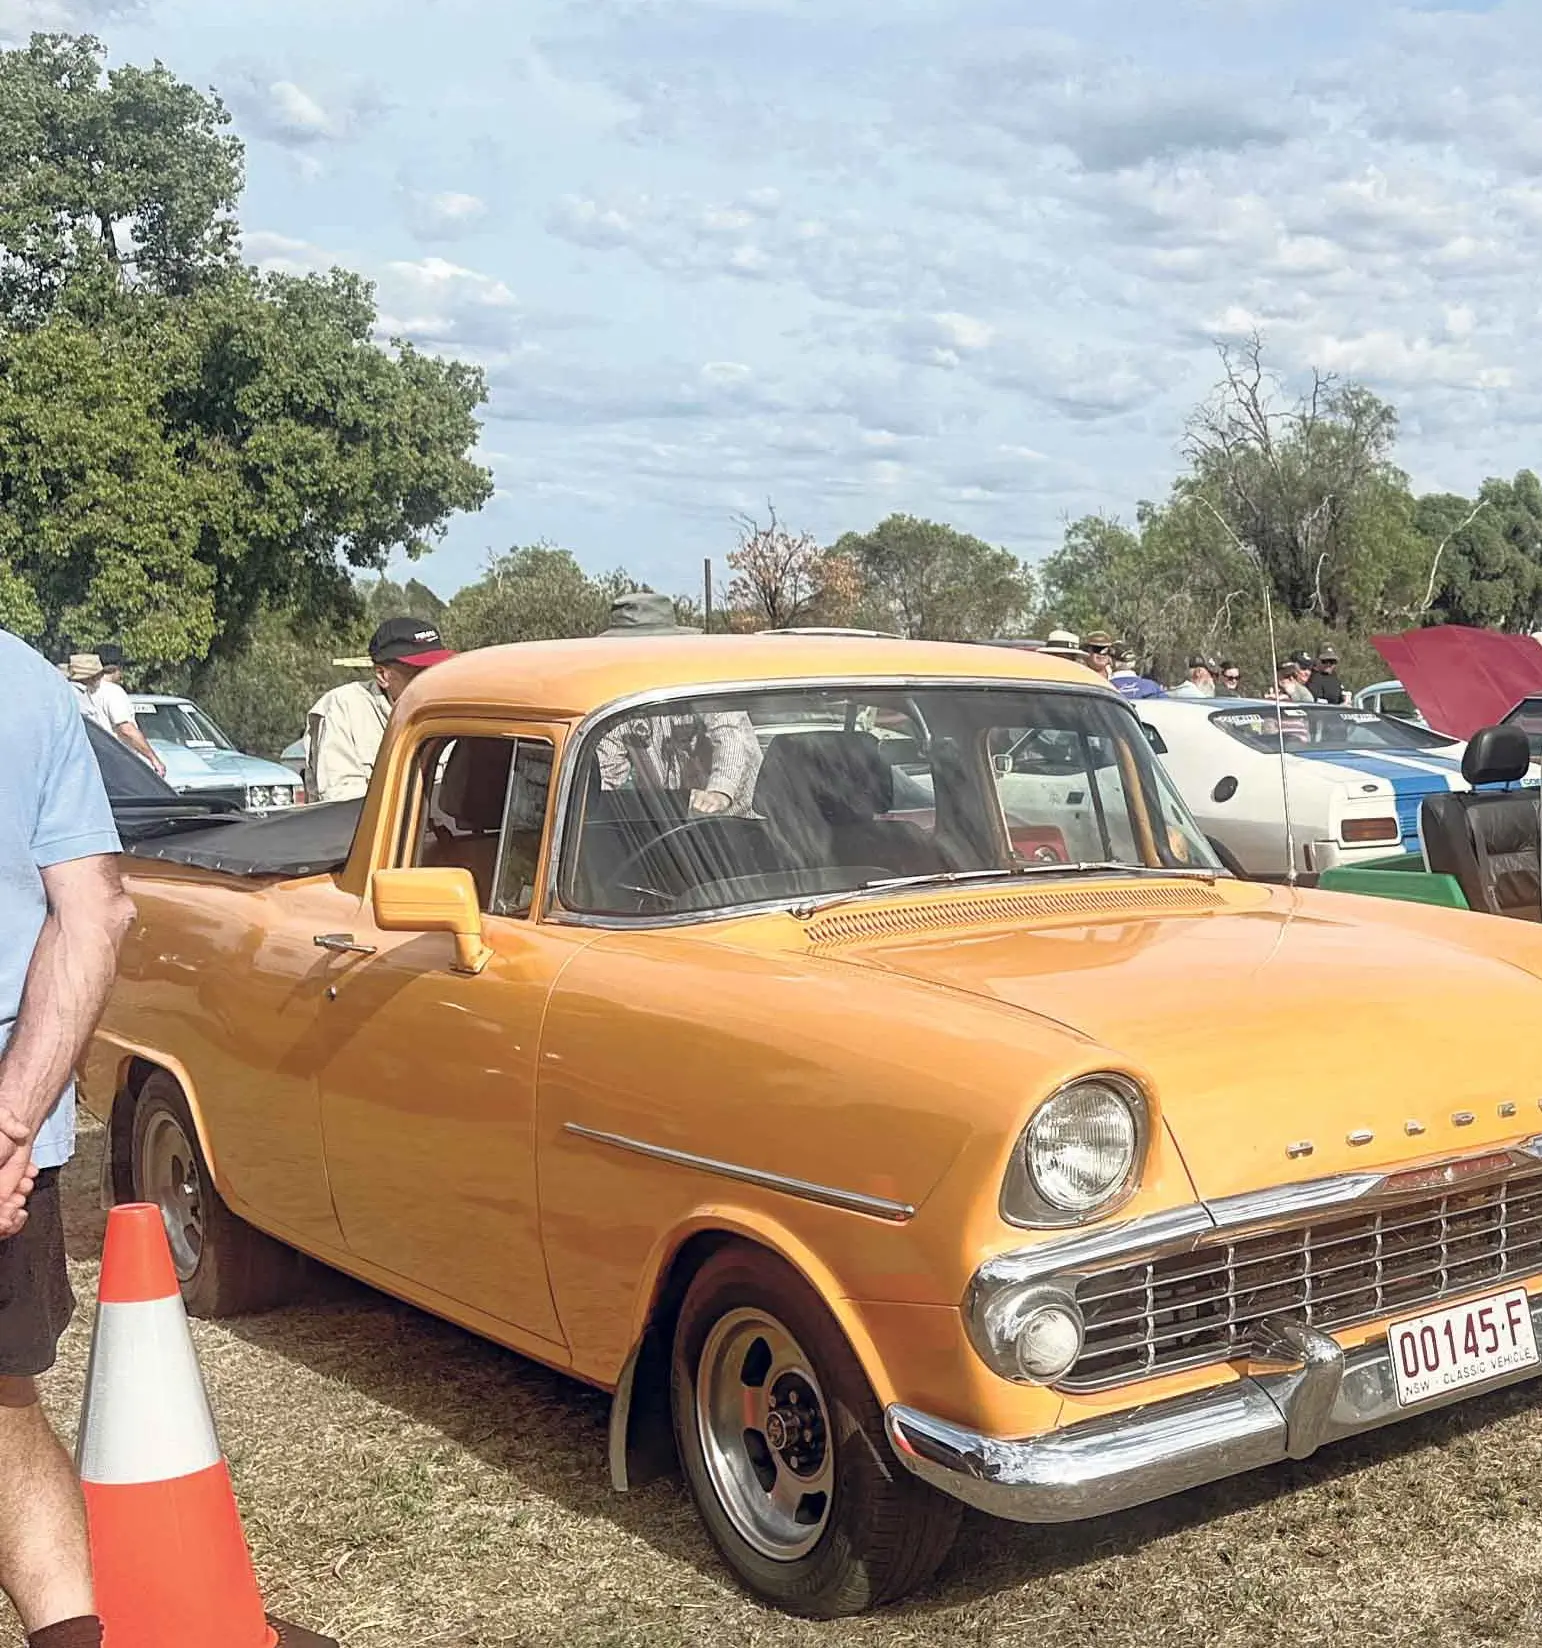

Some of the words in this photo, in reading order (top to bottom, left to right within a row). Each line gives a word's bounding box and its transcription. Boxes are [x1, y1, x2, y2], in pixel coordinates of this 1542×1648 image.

[1405, 1380, 1431, 1397] NSW
[1443, 1361, 1486, 1385] CLASSIC
[1490, 1349, 1533, 1370] VEHICLE
